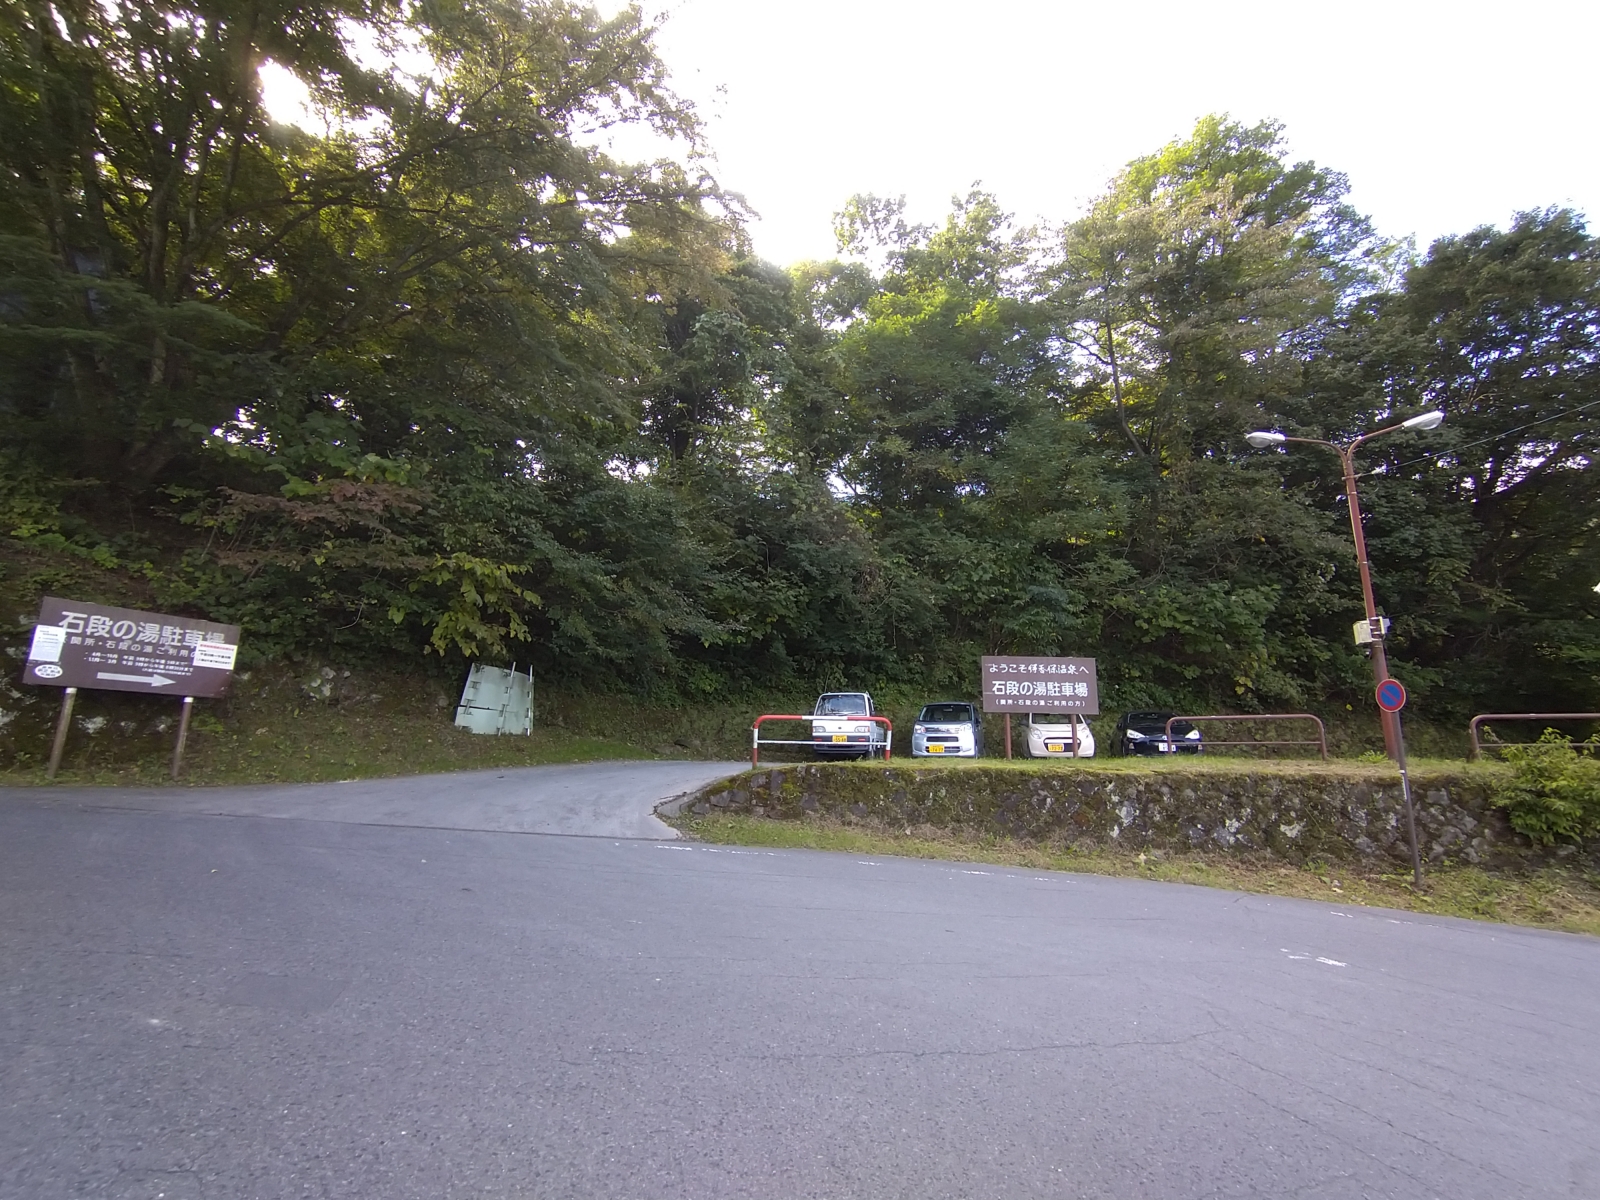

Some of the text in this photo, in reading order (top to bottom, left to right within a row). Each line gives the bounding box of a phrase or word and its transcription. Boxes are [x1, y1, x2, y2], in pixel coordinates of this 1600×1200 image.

[58, 611, 225, 648] 石段の湯駐車場
[63, 636, 195, 657] 関所・石段の湯ご利用の
[989, 663, 1089, 675] ようこそ伊香保温泉へ
[991, 680, 1089, 697] 石段の湯駐車場
